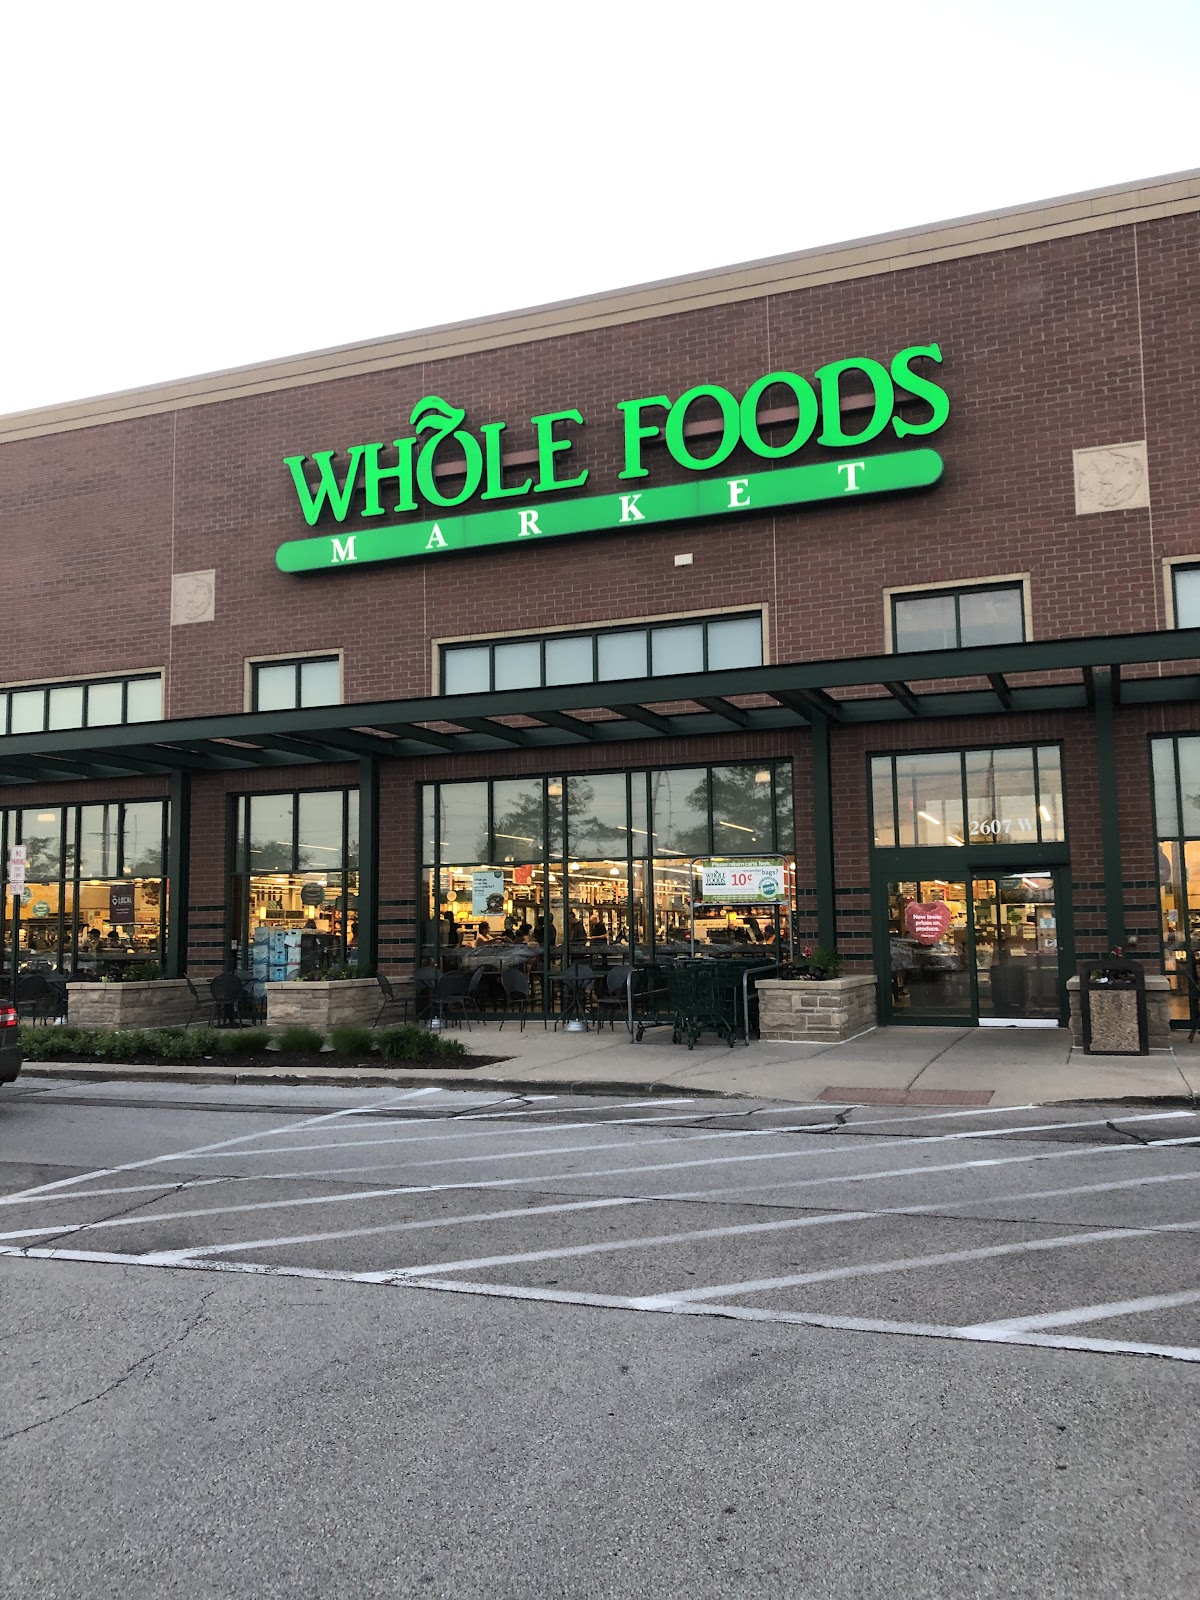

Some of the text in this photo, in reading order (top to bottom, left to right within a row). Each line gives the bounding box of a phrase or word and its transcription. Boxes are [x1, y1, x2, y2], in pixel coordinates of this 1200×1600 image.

[283, 343, 949, 526] WHOLE FOODS
[331, 462, 865, 563] MARKET
[969, 818, 1033, 836] 2607 W
[705, 870, 726, 878] WHOLE
[731, 873, 753, 886] 10¢
[761, 868, 779, 877] bags?
